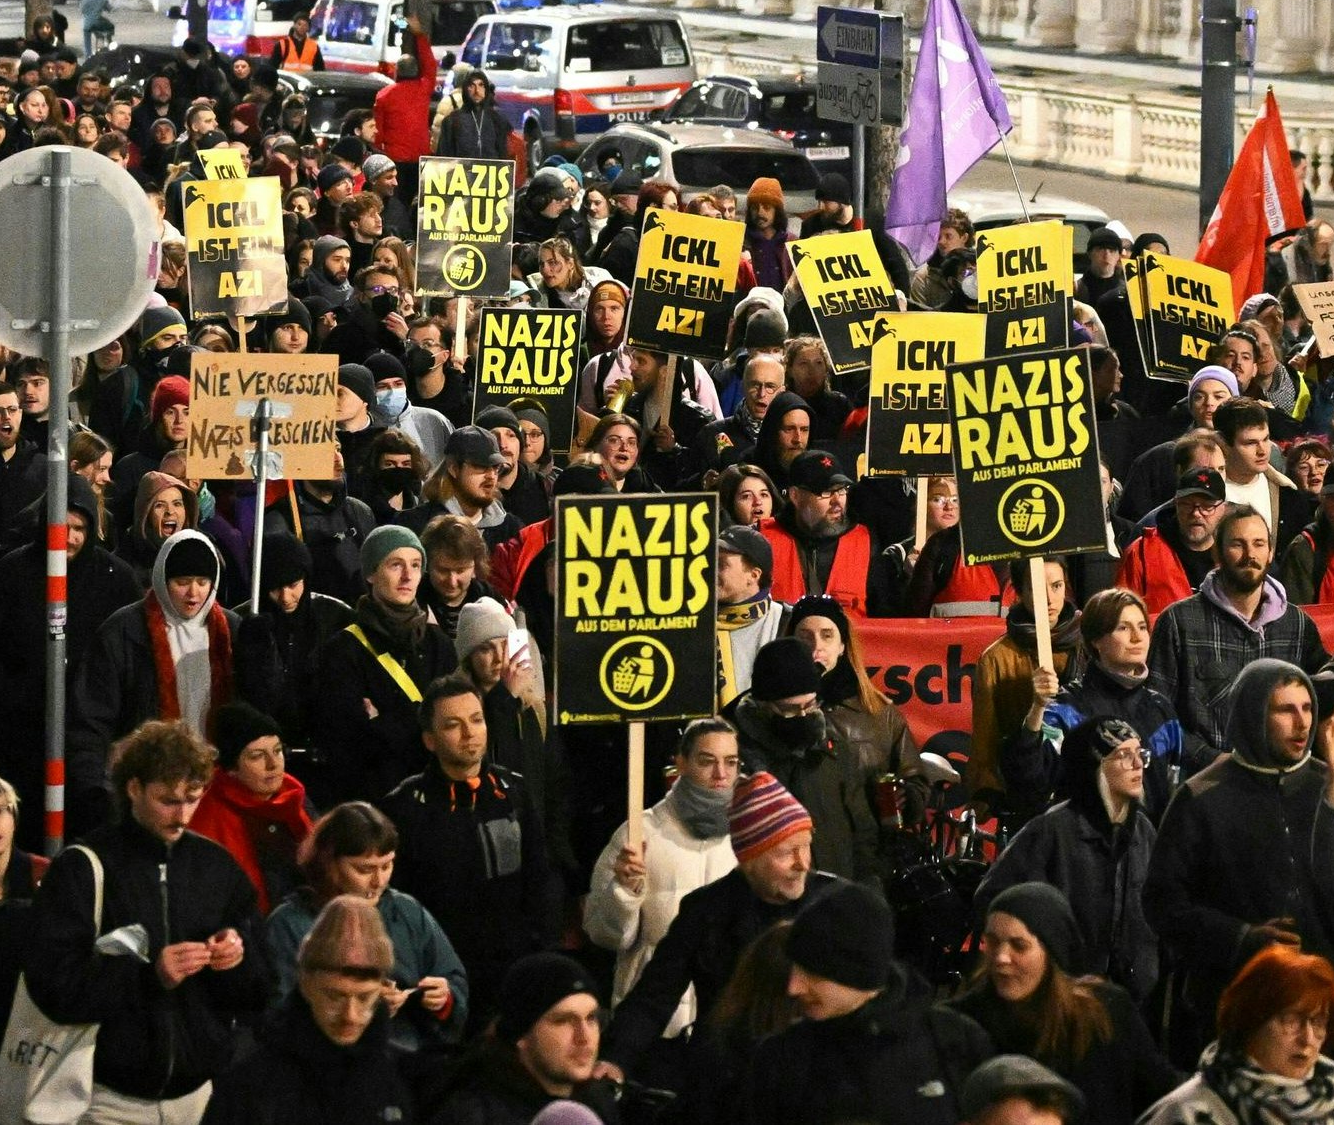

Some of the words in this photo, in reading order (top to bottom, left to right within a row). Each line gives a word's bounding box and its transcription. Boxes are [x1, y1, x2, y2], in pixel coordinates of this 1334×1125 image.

[836, 25, 874, 53] EINBAHN
[422, 161, 510, 198] NAZIS
[207, 201, 265, 229] ICKL
[423, 195, 509, 235] RAUS
[198, 237, 231, 263] IST
[237, 235, 274, 261] EIN
[428, 232, 442, 241] AUS
[443, 232, 459, 241] DEM
[460, 232, 502, 243] PARLAMENT
[661, 233, 720, 268] ICKL
[815, 253, 871, 284] ICKL
[996, 245, 1048, 278] ICKL
[218, 270, 263, 299] AZI
[644, 267, 684, 295] IST
[684, 274, 724, 303] EIN
[987, 286, 1018, 313] IST
[1023, 280, 1056, 308] EIN
[1166, 274, 1218, 308] ICKL
[818, 290, 855, 317] IST
[853, 286, 890, 312] EIN
[484, 313, 577, 349] NAZIS
[655, 305, 705, 338] AZI
[1005, 316, 1046, 349] AZI
[1160, 302, 1190, 326] IST
[1196, 309, 1227, 336] EIN
[1180, 334, 1212, 361] AZ
[237, 368, 336, 397] VERGESSEN
[481, 348, 574, 386] RAUS
[487, 386, 501, 394] AUS
[502, 386, 519, 395] DEM
[520, 386, 565, 396] PARLAMENT
[881, 383, 921, 411] IST
[952, 355, 1085, 418] NAZIS
[899, 423, 951, 455] AZI
[957, 401, 1090, 470] RAUS
[972, 469, 992, 483] AUS
[993, 465, 1017, 480] DEM
[1018, 457, 1083, 476] PARLAMENT
[564, 501, 710, 559] NAZIS
[564, 555, 710, 617] RAUS
[575, 618, 598, 633] AUS
[600, 618, 627, 632] DEM
[628, 616, 699, 632] PARLAMENT
